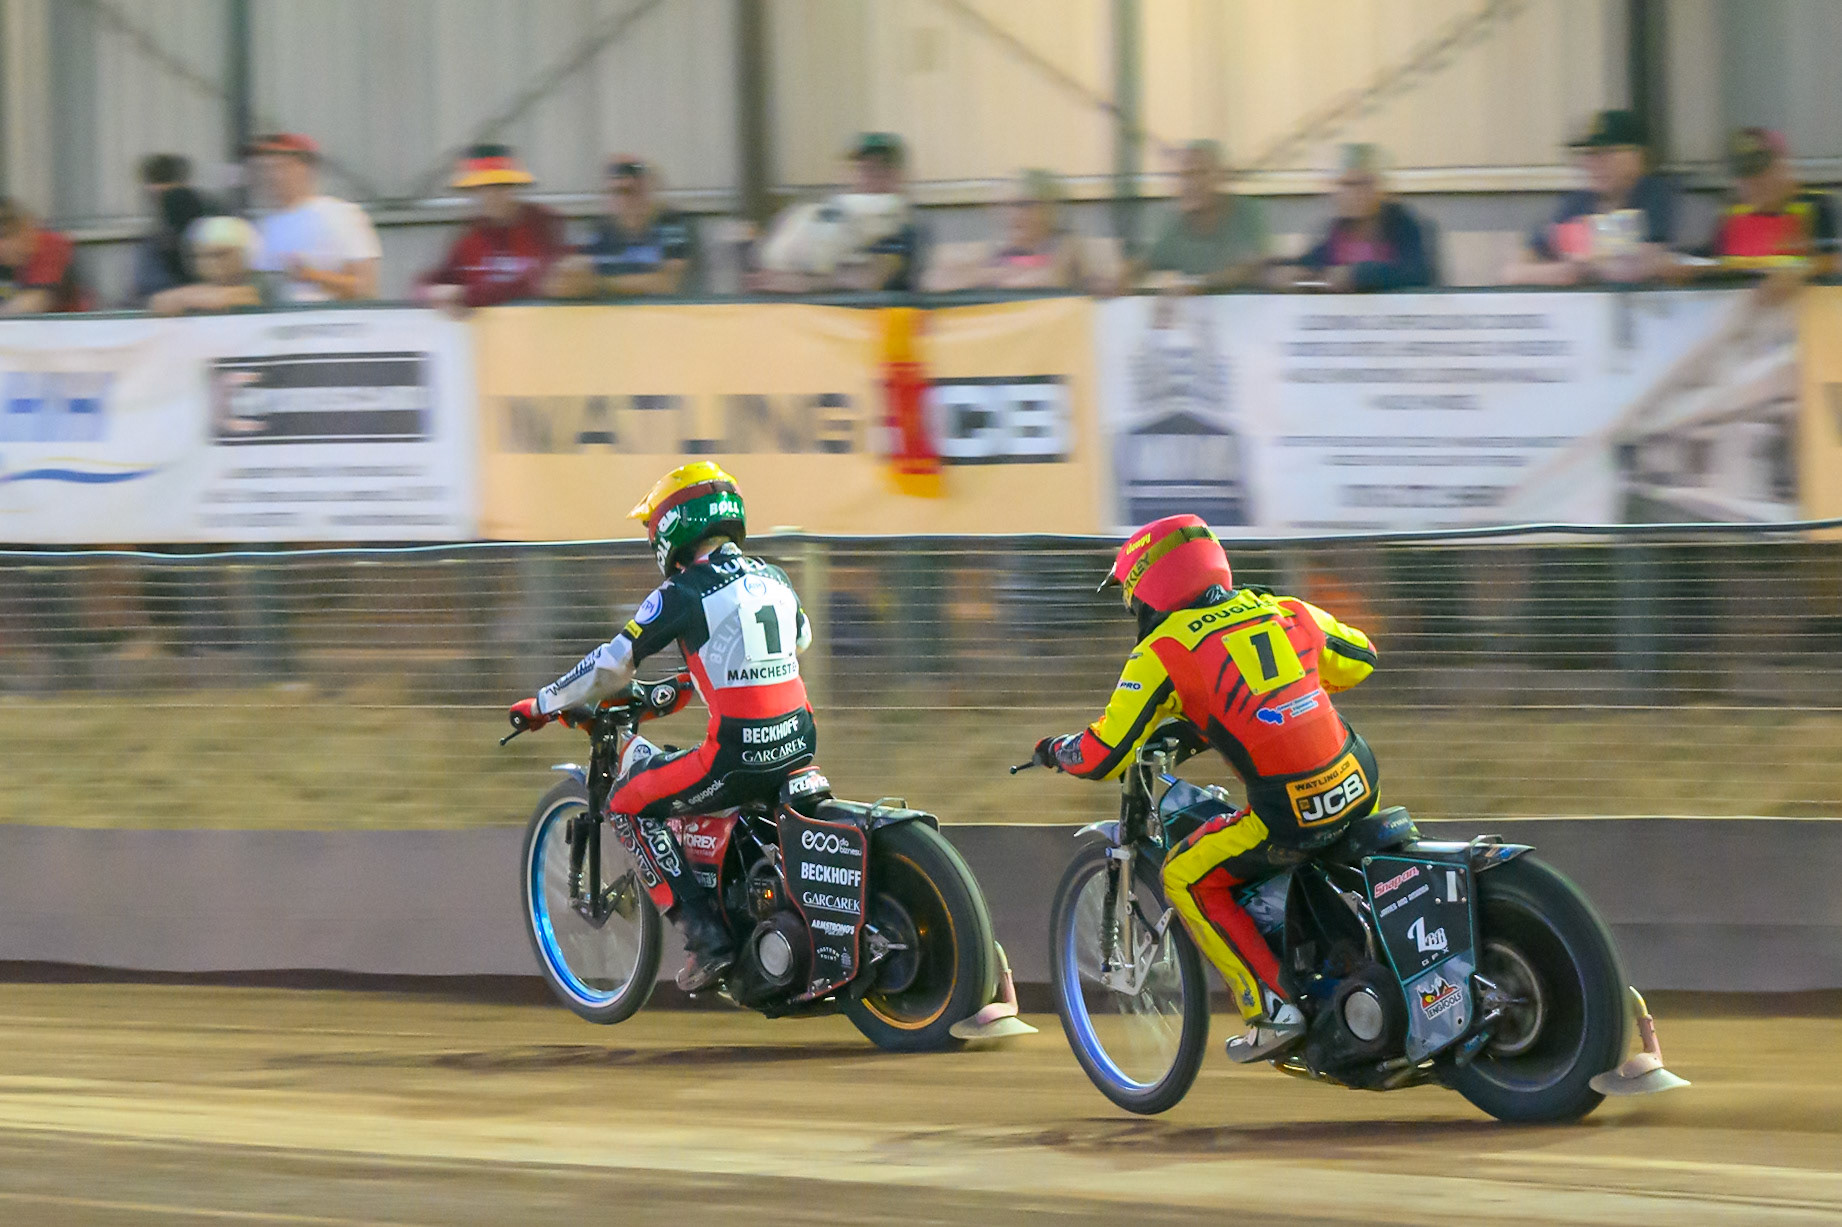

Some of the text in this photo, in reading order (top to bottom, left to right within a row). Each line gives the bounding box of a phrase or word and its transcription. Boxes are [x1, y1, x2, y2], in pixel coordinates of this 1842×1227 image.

[709, 614, 742, 665] BELL
[754, 605, 782, 655] 1
[1249, 631, 1279, 681] 1
[742, 715, 799, 744] BECKHOFF
[742, 736, 807, 763] GARCAREK
[688, 778, 725, 806] aquapak
[1294, 770, 1339, 792] WATLING
[1302, 773, 1365, 821] JCB
[801, 829, 840, 855] eco
[800, 861, 862, 887] BECKHOFF
[802, 891, 861, 912] GARCAREK
